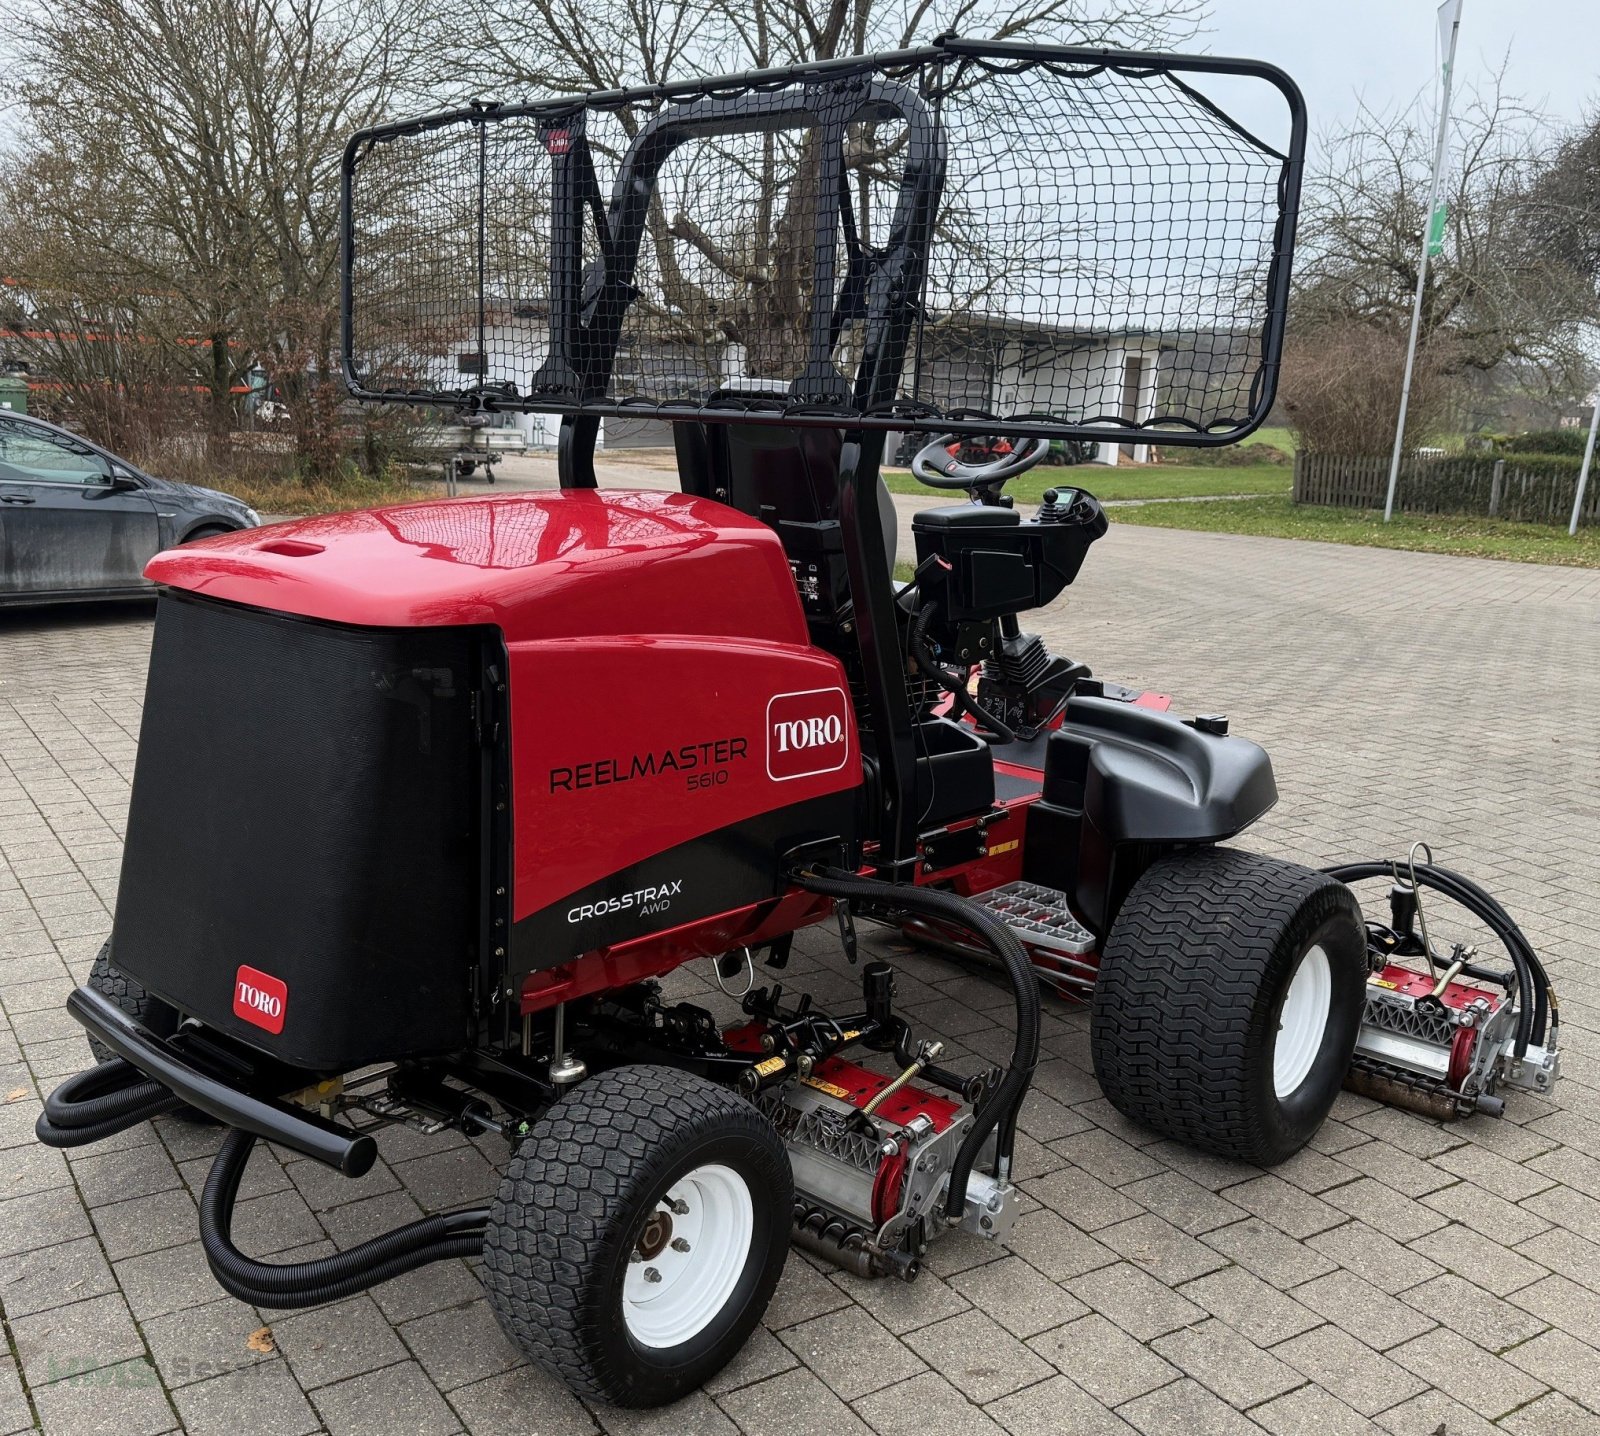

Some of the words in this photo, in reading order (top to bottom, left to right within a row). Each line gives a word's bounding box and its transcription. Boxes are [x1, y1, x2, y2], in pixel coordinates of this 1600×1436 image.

[773, 714, 842, 753] TORO
[550, 737, 748, 794] REELMASTER
[686, 769, 729, 791] 5610
[567, 879, 682, 923] CROSSTRAX
[638, 898, 671, 918] AWD
[237, 980, 282, 1018] TORO
